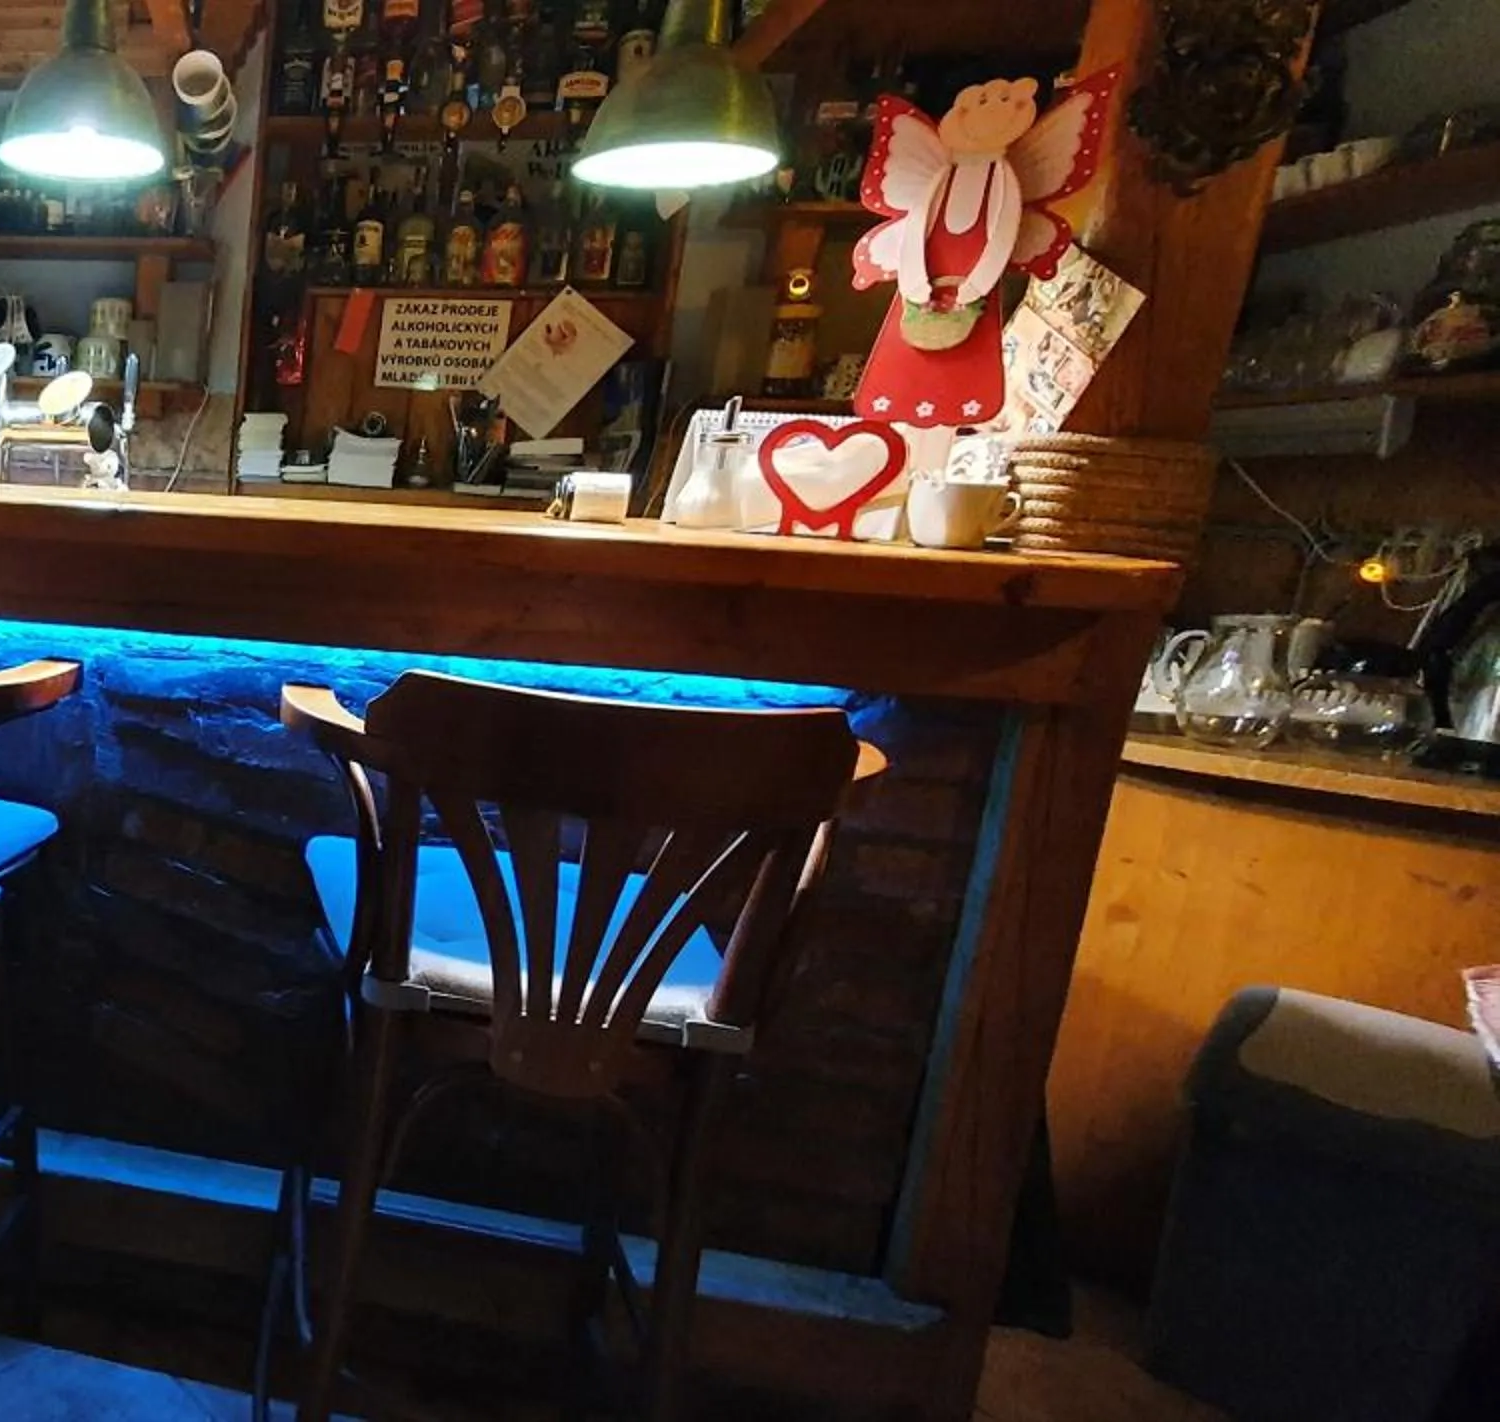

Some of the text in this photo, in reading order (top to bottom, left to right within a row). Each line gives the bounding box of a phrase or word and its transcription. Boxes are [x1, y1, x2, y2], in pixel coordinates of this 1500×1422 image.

[441, 304, 499, 317] PRODEJE
[391, 320, 499, 335] ALKOHOLICKÝCH
[393, 337, 491, 352] A TABÁKOVÝCH
[381, 353, 440, 367] VÝROBKŮ
